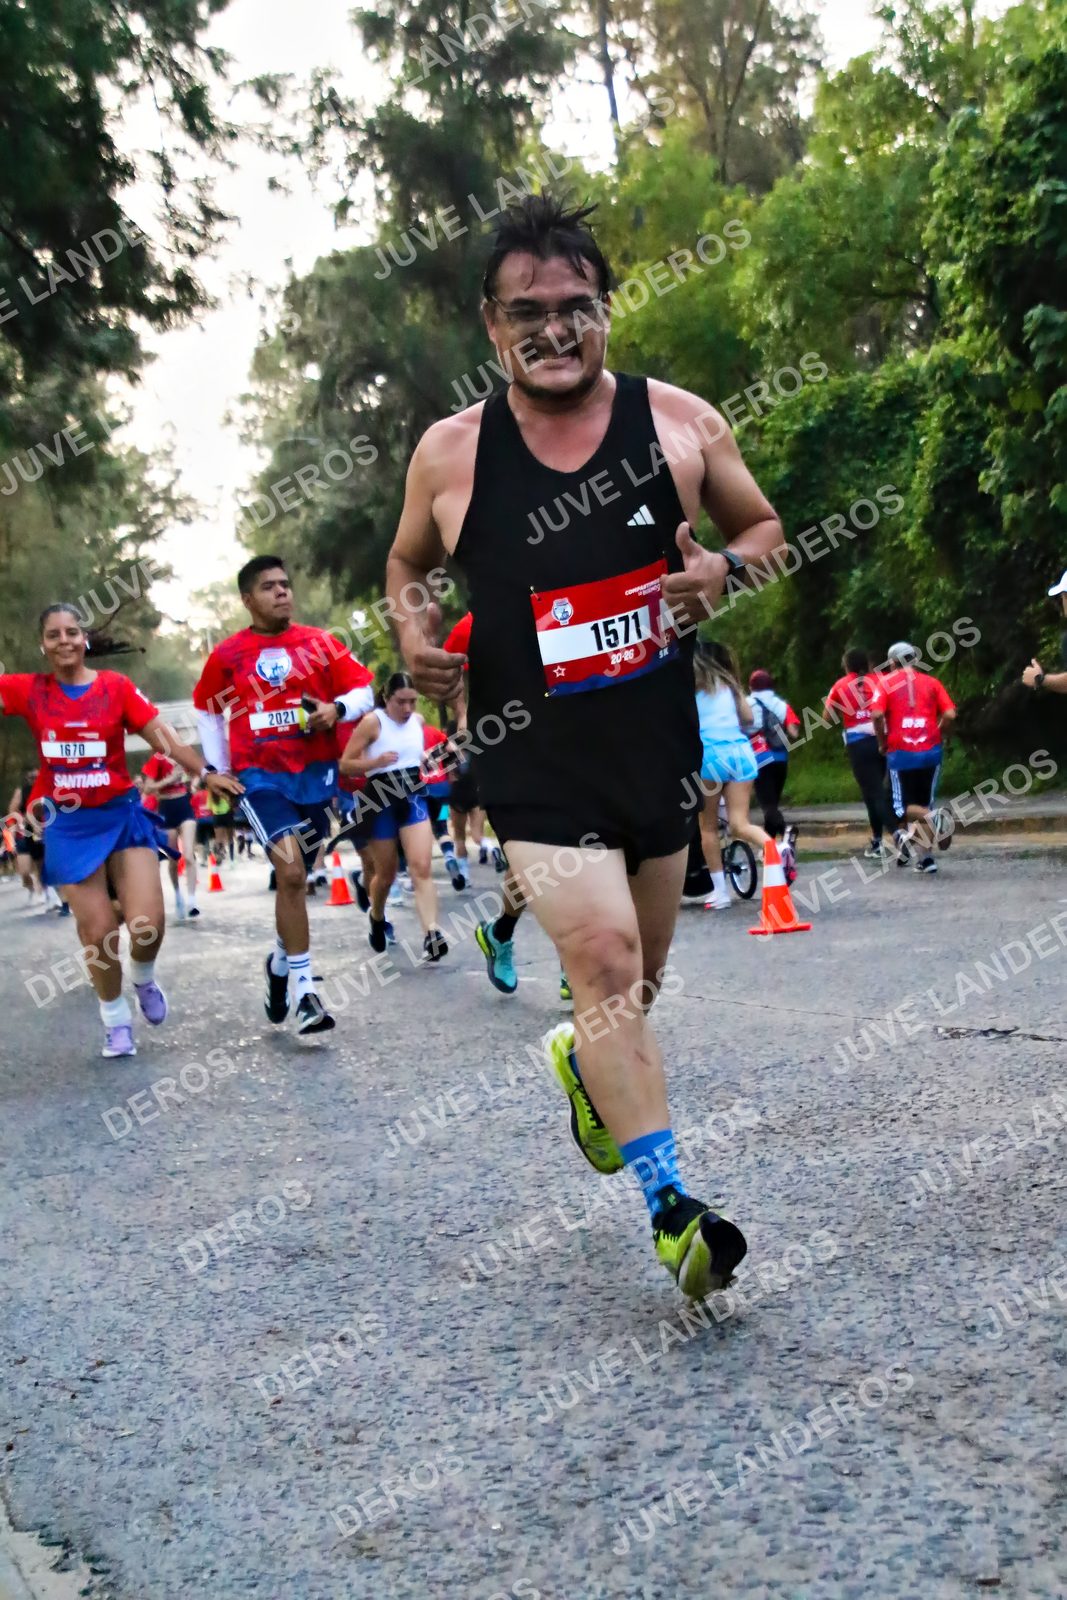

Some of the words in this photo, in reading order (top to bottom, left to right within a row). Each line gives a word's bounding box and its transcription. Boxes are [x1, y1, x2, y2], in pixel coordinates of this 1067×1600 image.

[590, 611, 642, 651] 1571
[610, 648, 635, 664] 20-26
[268, 710, 296, 726] 2021
[60, 744, 85, 756] 1670
[54, 771, 111, 788] SANTIAGO
